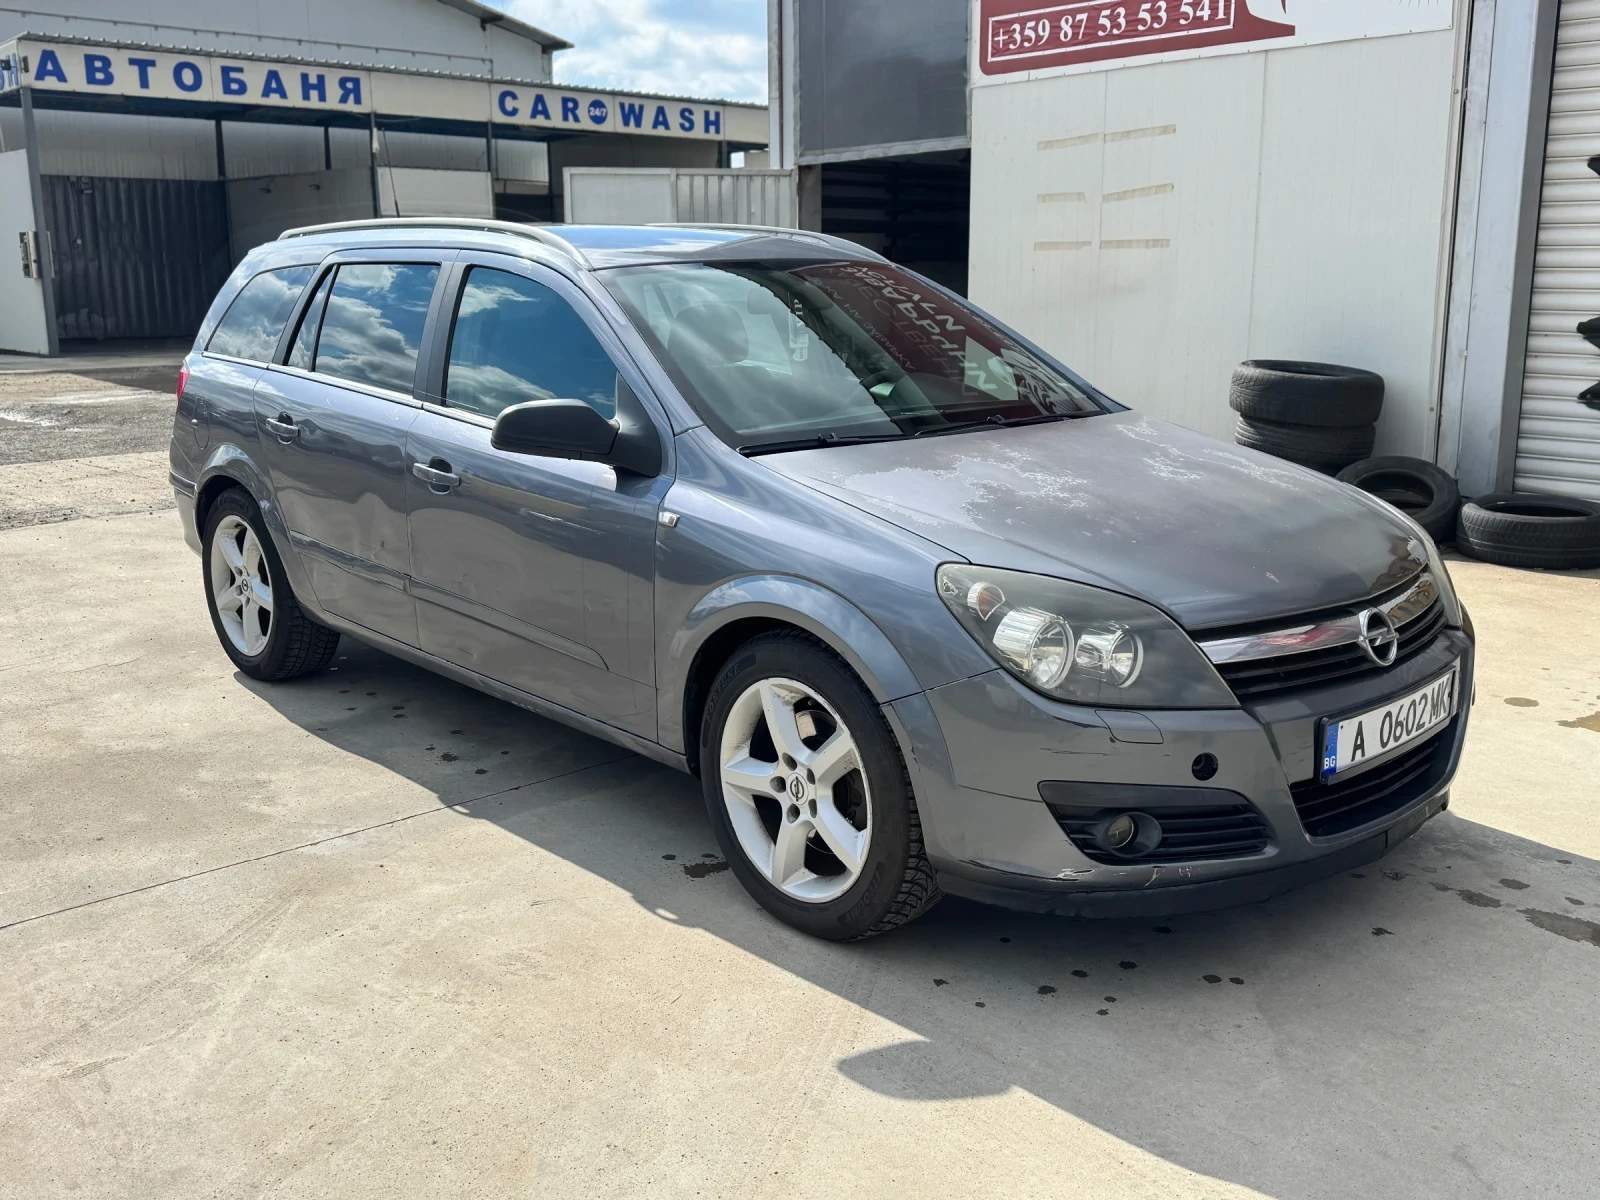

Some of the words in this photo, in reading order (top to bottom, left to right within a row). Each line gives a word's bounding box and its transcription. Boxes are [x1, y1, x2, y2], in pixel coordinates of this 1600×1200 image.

[994, 18, 1050, 50] +359
[1060, 12, 1088, 41] 87
[1098, 6, 1126, 36] 53
[1137, 1, 1167, 31] 53
[1179, 0, 1227, 25] 541
[34, 49, 364, 106] АВТОБАНЯ
[498, 89, 581, 123] CAR
[589, 106, 607, 118] 24/7
[619, 101, 721, 135] WASH
[1323, 755, 1336, 769] BG
[1350, 719, 1366, 763] A
